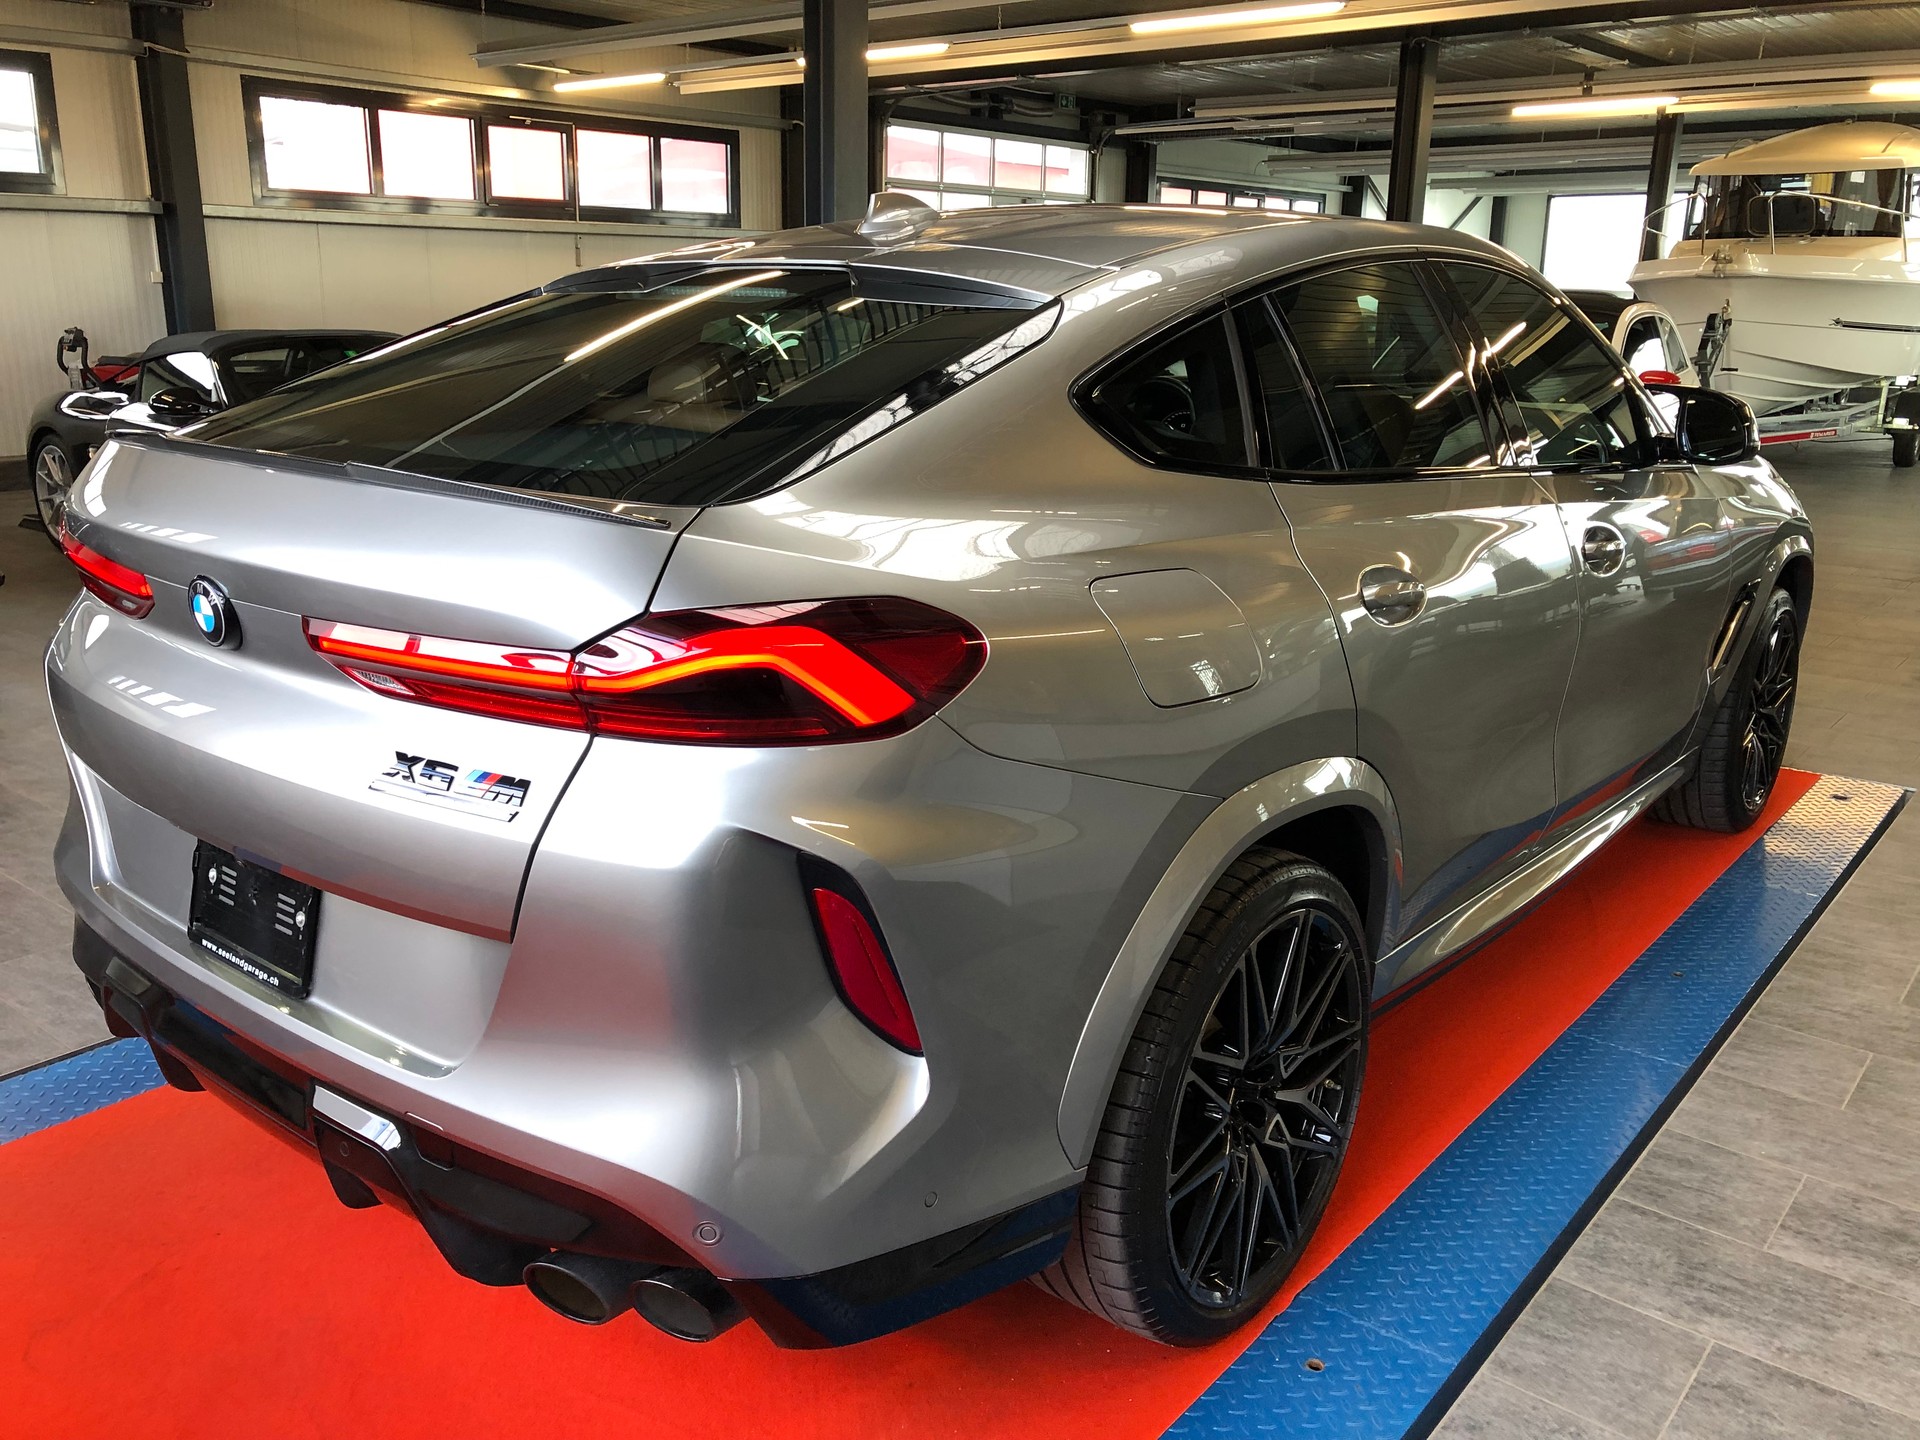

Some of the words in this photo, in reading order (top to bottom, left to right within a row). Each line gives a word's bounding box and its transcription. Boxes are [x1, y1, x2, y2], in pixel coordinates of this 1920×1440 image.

[190, 583, 217, 606] BMW
[382, 751, 459, 791] X6
[478, 770, 531, 807] M
[200, 937, 279, 987] www.seelandgarage.ch
